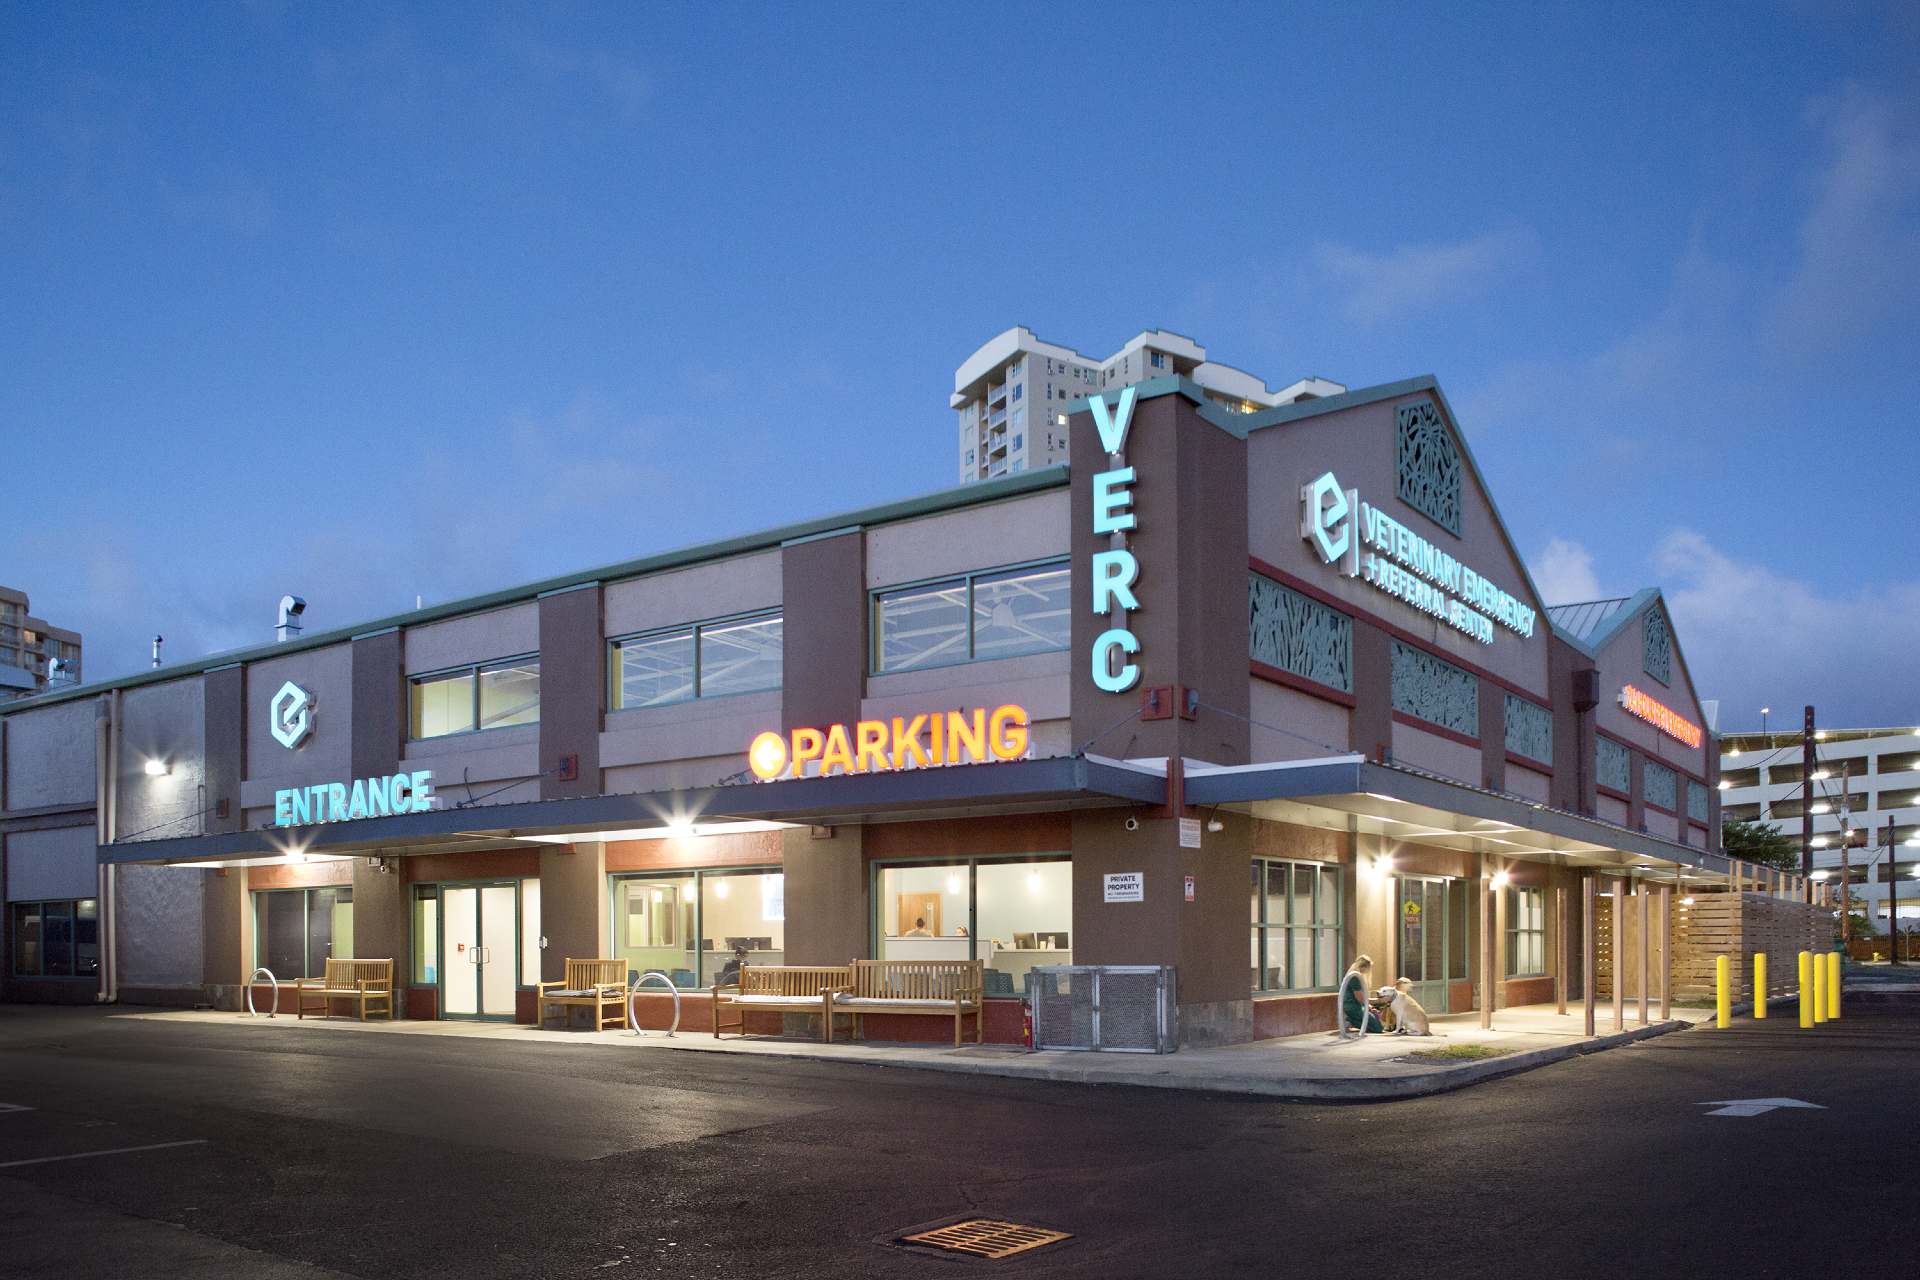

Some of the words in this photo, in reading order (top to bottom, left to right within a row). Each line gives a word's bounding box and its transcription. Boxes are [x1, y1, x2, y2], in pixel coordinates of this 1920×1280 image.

[1088, 386, 1141, 694] VERC
[1361, 501, 1463, 593] VETERINARY
[1462, 565, 1536, 638] EMERGENCY
[1379, 557, 1449, 617] REFERRAL
[1449, 599, 1494, 645] CENTER
[791, 704, 1030, 777] PARKING
[275, 769, 433, 827] ENTRANCE
[1107, 883, 1140, 891] PROPERTY
[1110, 875, 1136, 883] PRIVATE
